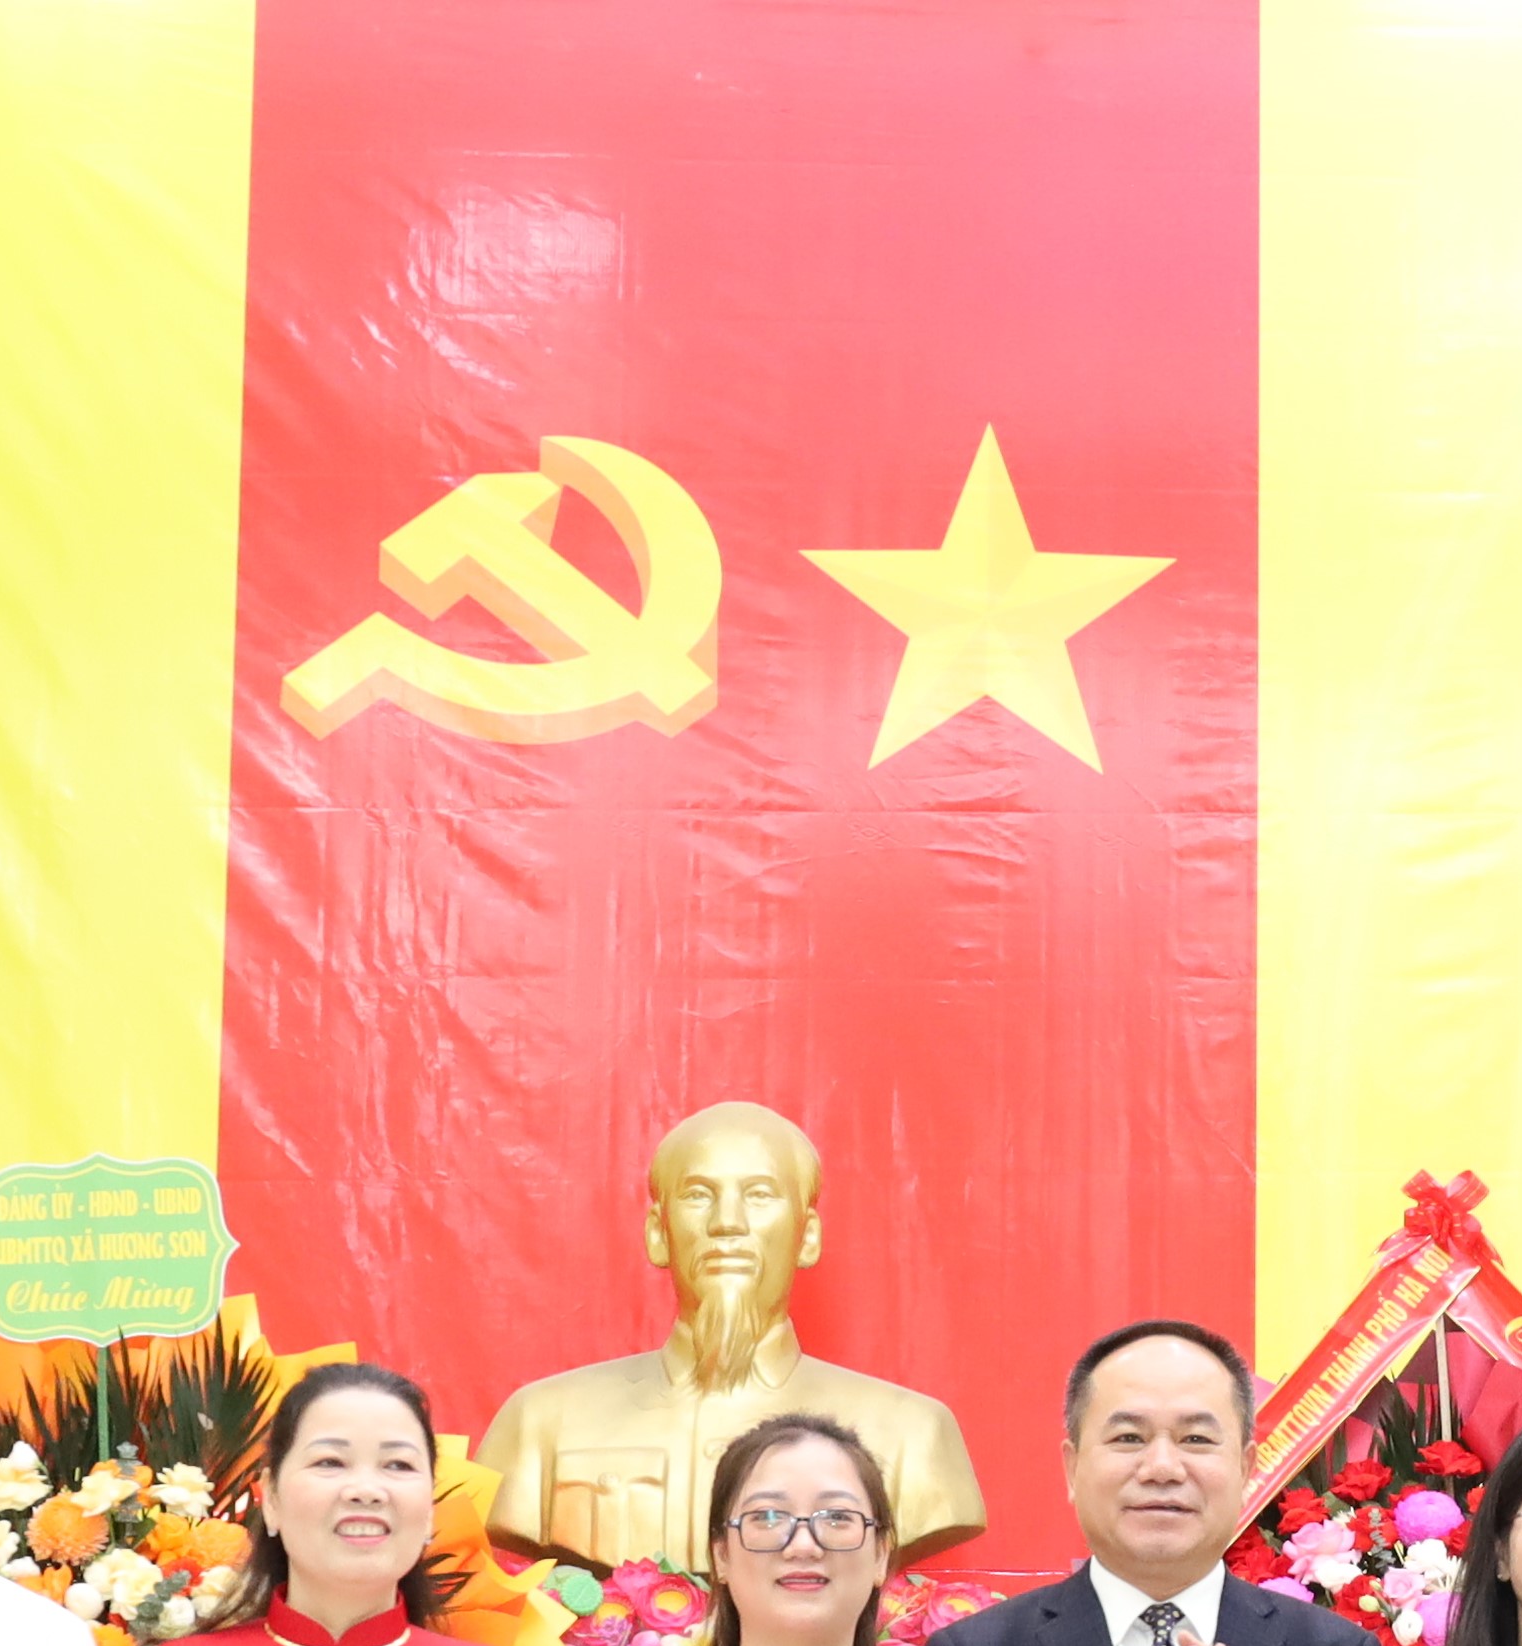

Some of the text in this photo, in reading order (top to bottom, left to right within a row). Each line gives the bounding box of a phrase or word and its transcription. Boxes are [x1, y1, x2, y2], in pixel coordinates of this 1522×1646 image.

[71, 1228, 95, 1262] XÃ
[99, 1231, 164, 1261] HƯƠNG
[168, 1229, 207, 1258] SƠN
[5, 1276, 197, 1315] Chúc Mừng
[1320, 1331, 1380, 1394] THÀNH
[1365, 1290, 1409, 1343] PHỐ
[1393, 1273, 1430, 1309] HÀ
